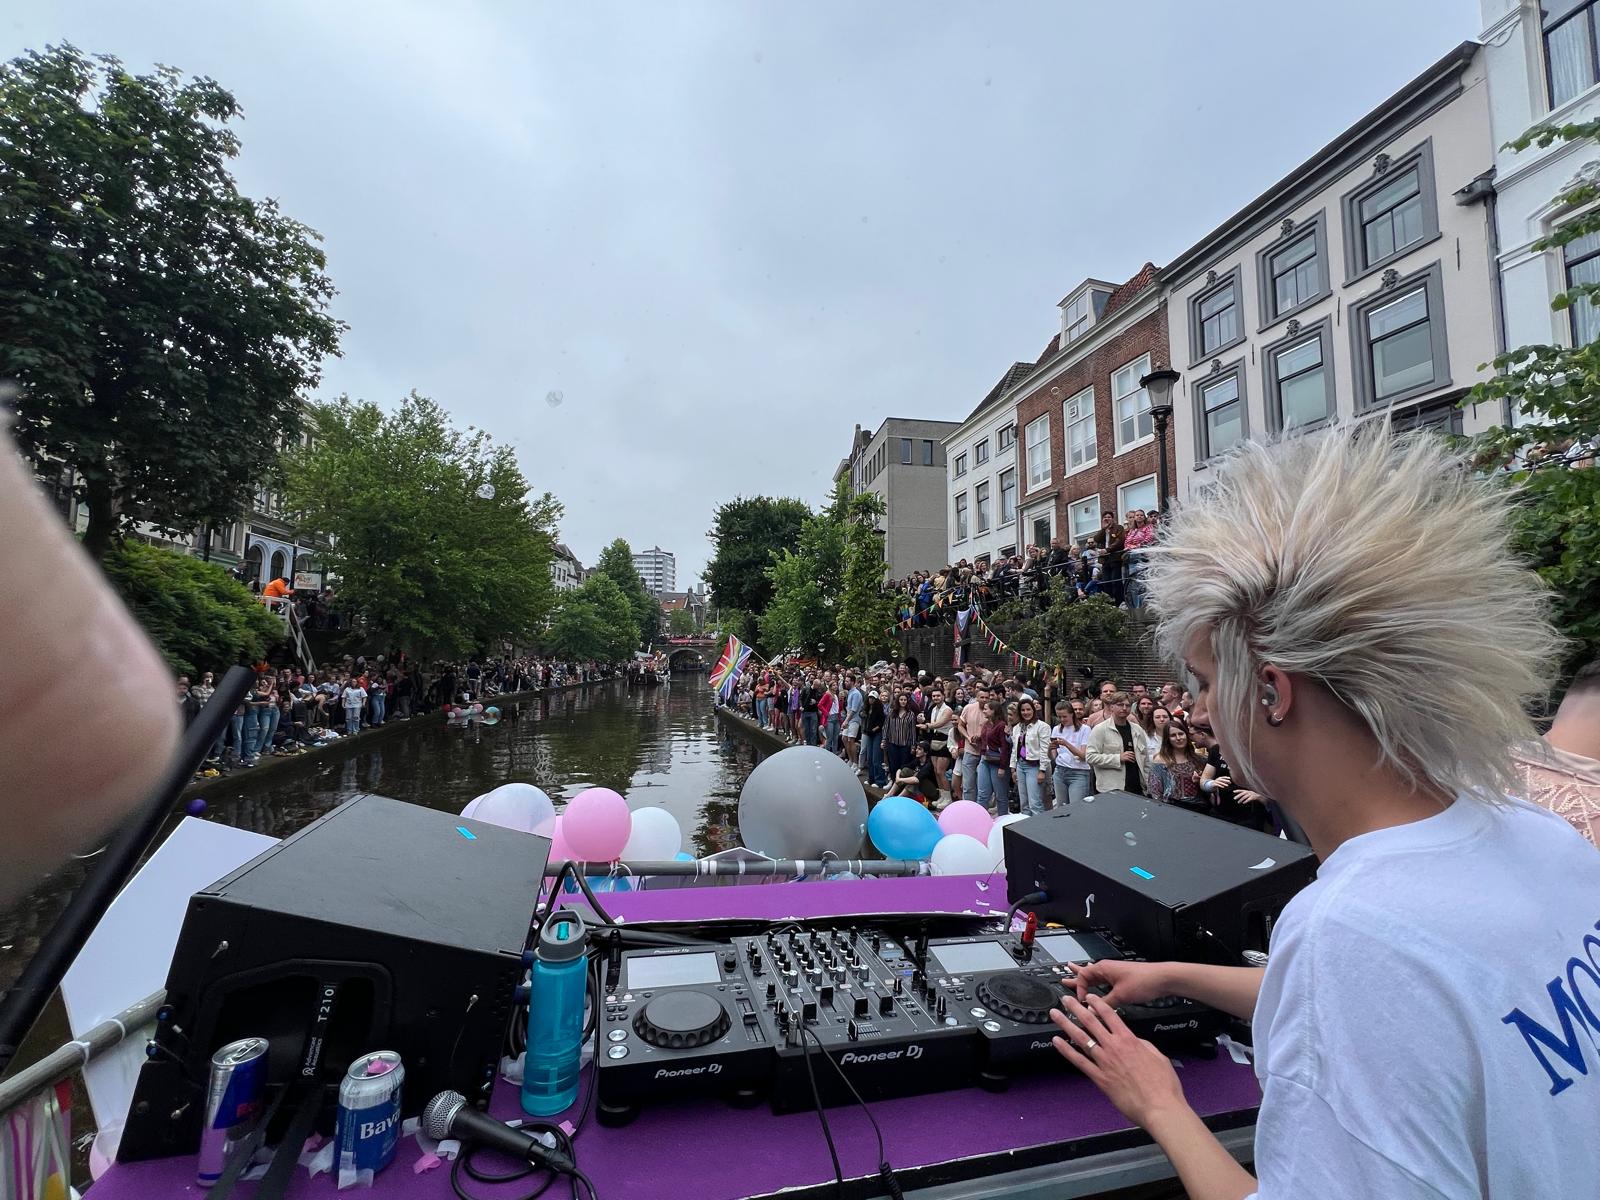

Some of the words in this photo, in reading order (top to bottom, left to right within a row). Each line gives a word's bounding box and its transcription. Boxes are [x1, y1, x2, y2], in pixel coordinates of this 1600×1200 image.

[1153, 1022, 1188, 1032] Pioneer
[840, 1050, 904, 1065] Pioneer
[654, 1066, 707, 1079] Pioneer
